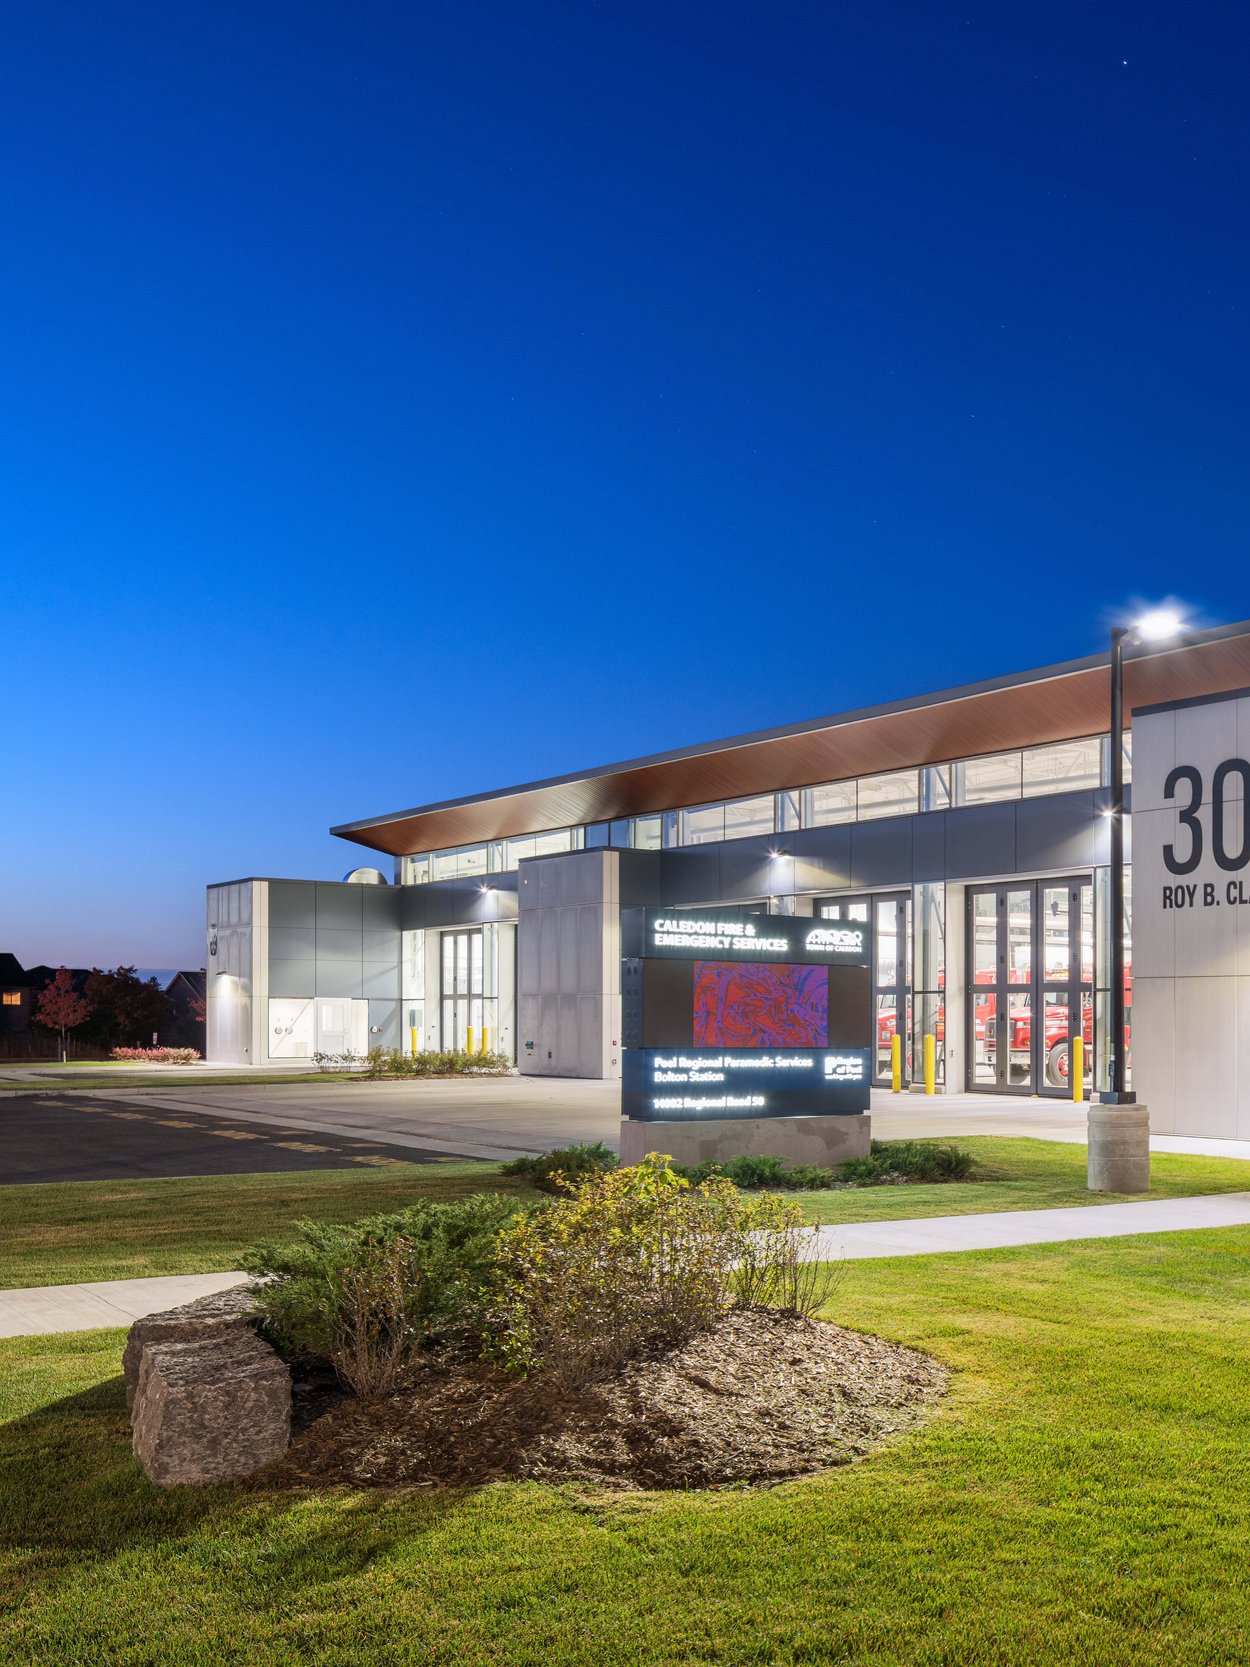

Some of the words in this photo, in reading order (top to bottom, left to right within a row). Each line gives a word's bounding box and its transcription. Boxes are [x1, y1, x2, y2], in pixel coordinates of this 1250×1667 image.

[1163, 884, 1197, 909] ROY
[1203, 883, 1220, 906] B.
[655, 920, 715, 934] CALEDON
[717, 923, 744, 935] FIRE
[745, 924, 755, 936] &
[655, 934, 731, 948] EMERGENCY
[732, 937, 788, 951] SERVICES
[654, 1057, 677, 1068] Peel
[678, 1056, 723, 1070] Regional
[724, 1056, 774, 1067] Paramedic
[775, 1056, 814, 1067] Services
[654, 1071, 688, 1082] Bolton
[688, 1071, 724, 1082] Station
[684, 1096, 726, 1110] Regional
[726, 1096, 751, 1106] Road
